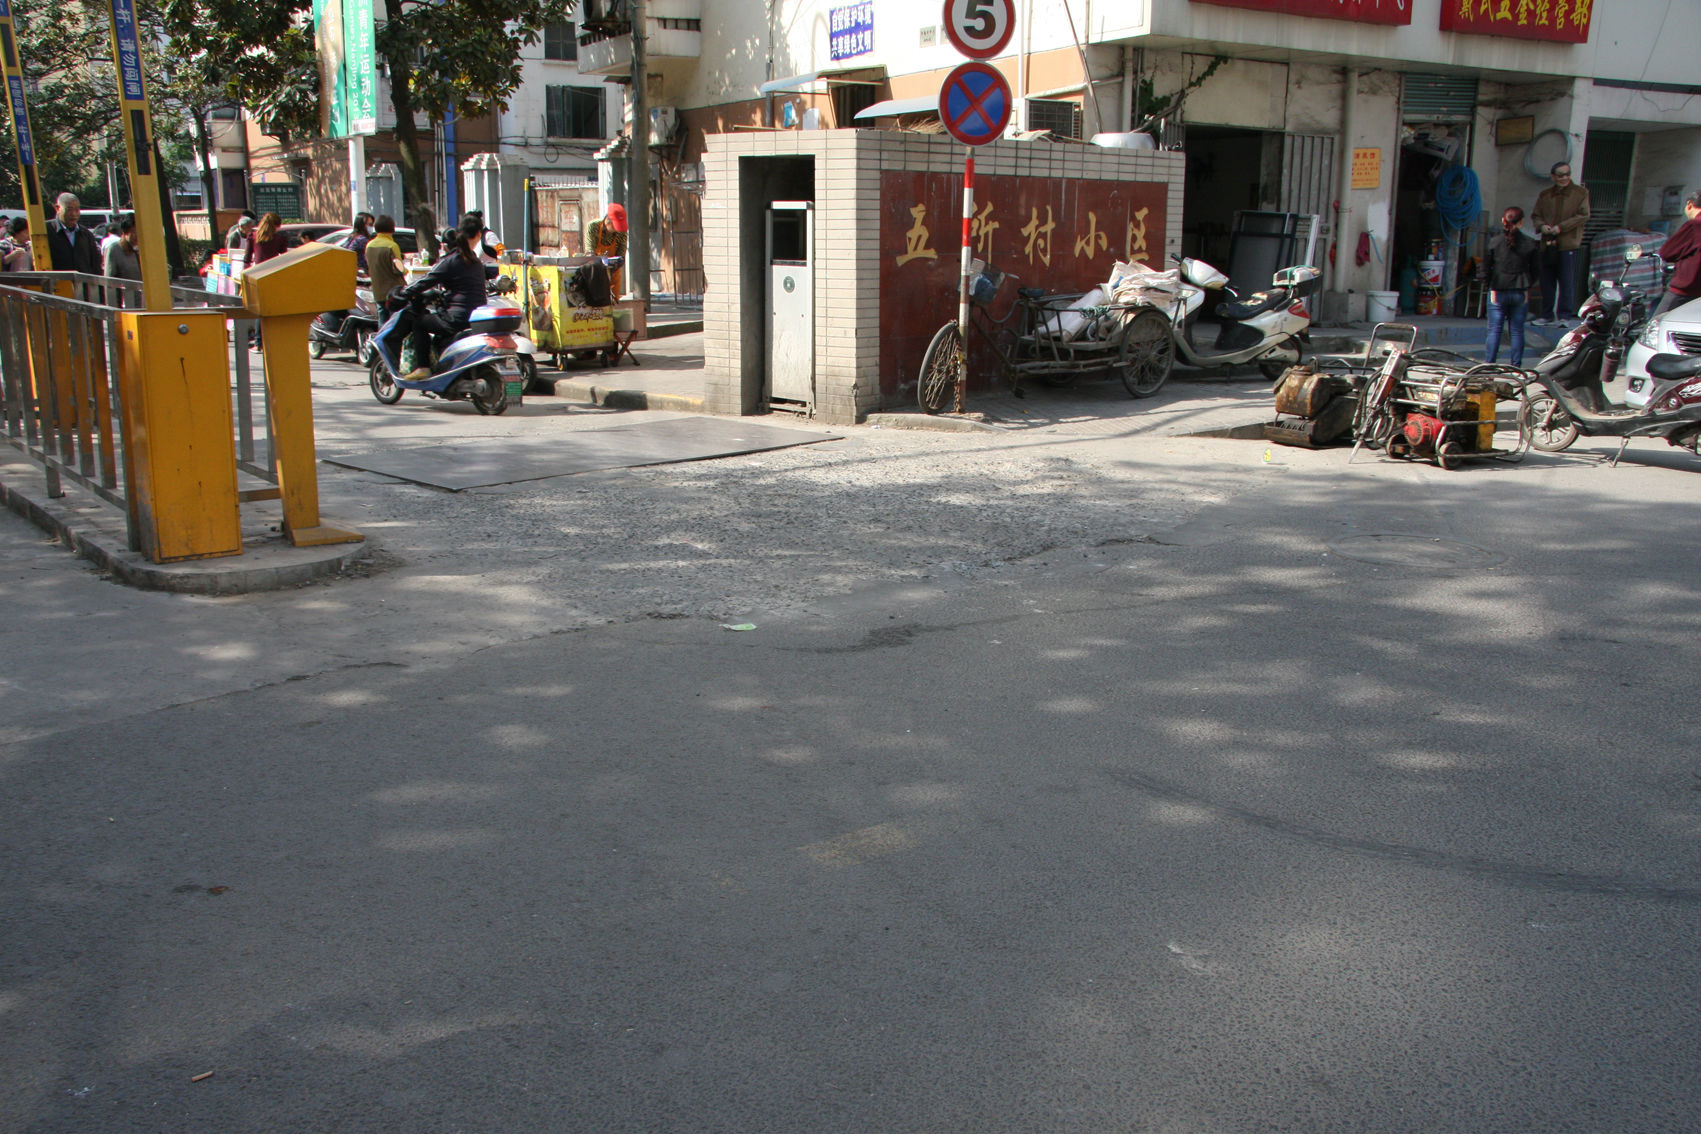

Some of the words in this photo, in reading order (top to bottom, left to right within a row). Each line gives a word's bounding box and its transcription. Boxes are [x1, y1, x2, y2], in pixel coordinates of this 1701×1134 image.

[832, 4, 872, 32] 自觉保护环境
[963, 0, 996, 40] 5
[832, 30, 872, 58] 共享绿色文明
